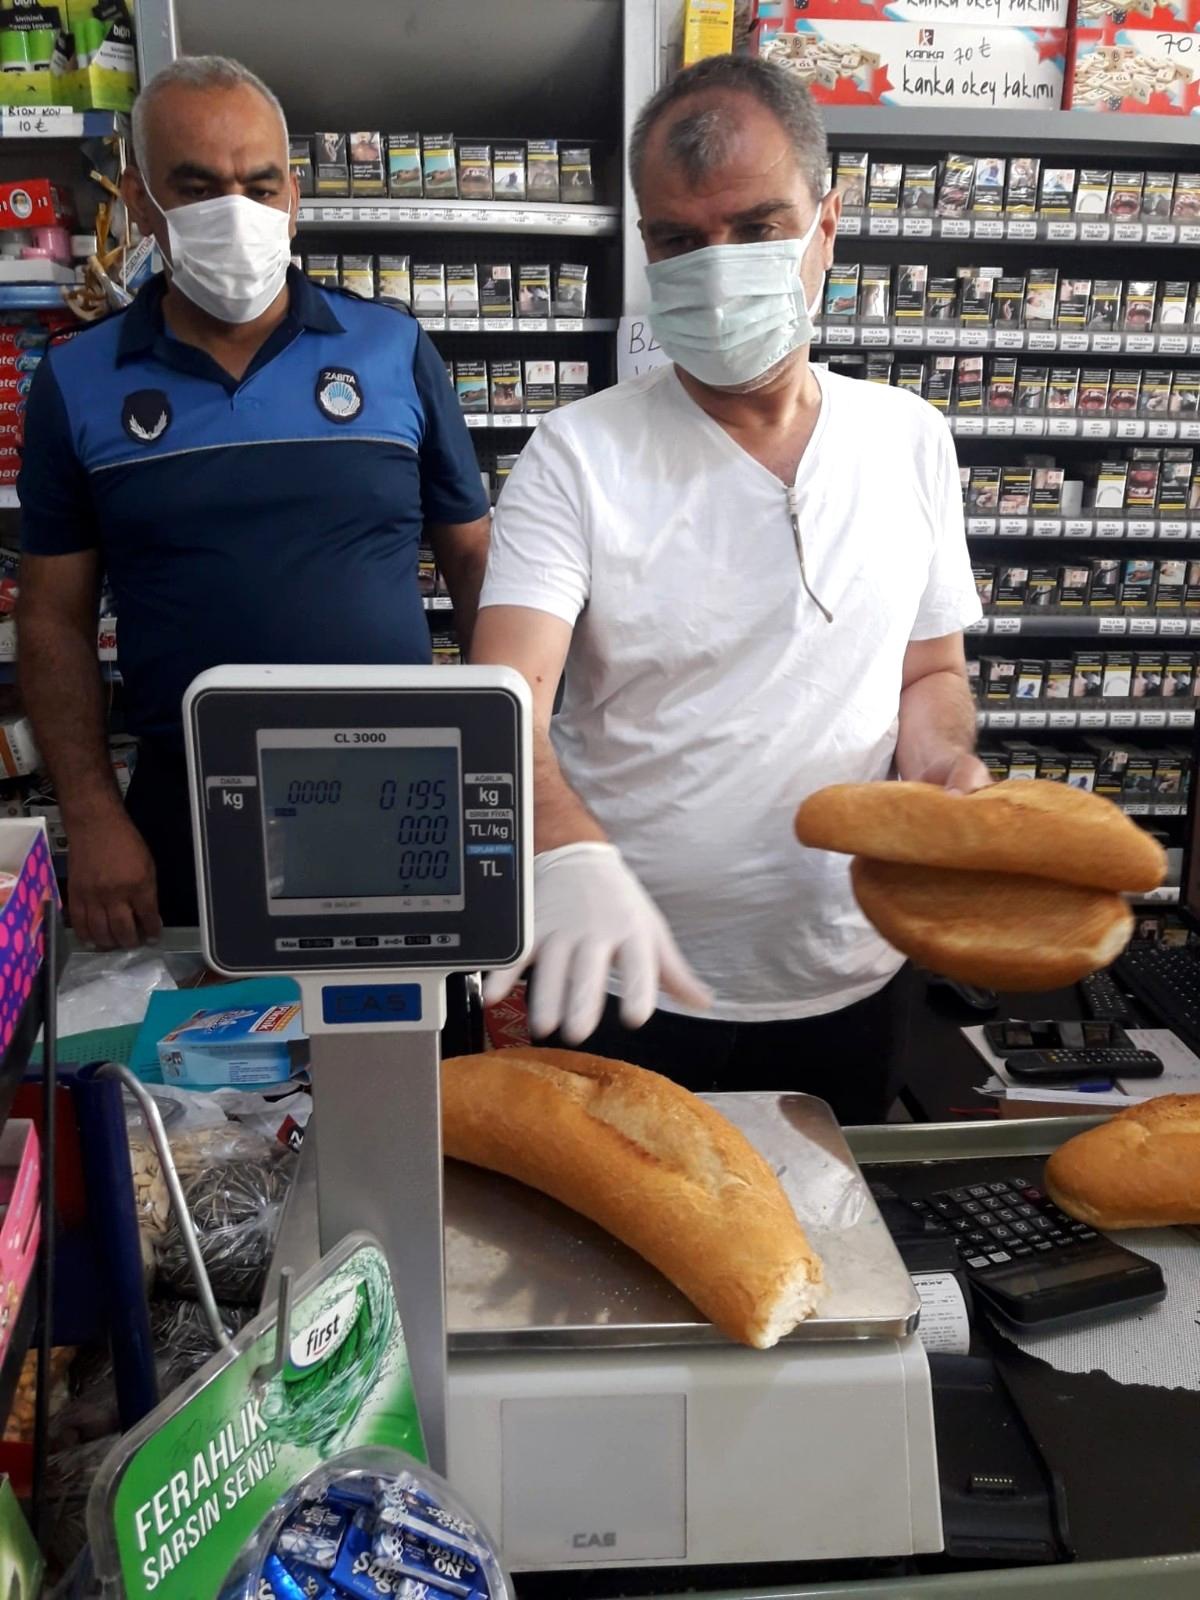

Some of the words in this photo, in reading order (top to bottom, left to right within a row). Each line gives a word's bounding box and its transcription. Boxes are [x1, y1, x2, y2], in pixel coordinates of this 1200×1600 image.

[1156, 33, 1193, 54] 70
[905, 50, 944, 59] KANKA
[954, 46, 973, 65] 70
[903, 65, 954, 95] kanka
[962, 72, 996, 105] okey
[0, 377, 17, 388] ate
[324, 372, 356, 384] ZABITA
[334, 732, 351, 744] CL
[352, 732, 387, 744] 3000
[222, 789, 244, 809] kg
[479, 786, 500, 806] kg
[468, 824, 509, 839] TL/kg
[479, 860, 503, 877] TL
[306, 1314, 341, 1358] first
[134, 1399, 268, 1552] FERAHLIK
[143, 1492, 221, 1592] SARSIN
[572, 1532, 617, 1548] CAS
[434, 1558, 462, 1579] NO
